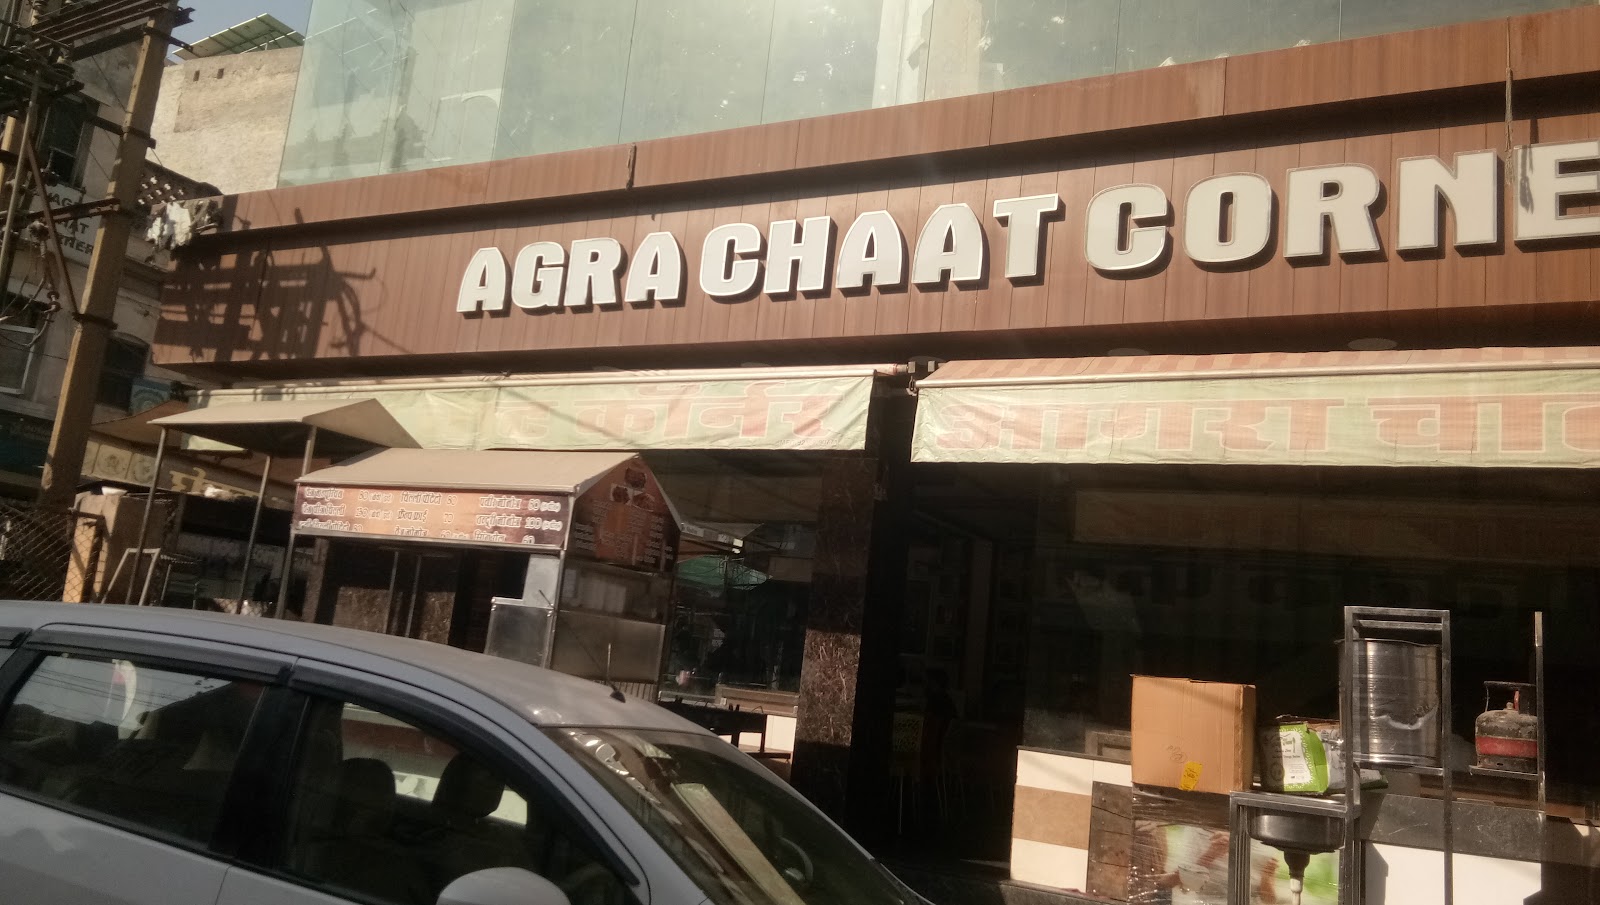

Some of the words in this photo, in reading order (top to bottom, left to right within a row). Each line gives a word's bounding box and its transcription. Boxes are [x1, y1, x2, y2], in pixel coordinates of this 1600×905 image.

[457, 231, 681, 313] AGRA
[699, 193, 1059, 297] CHAAT
[1084, 140, 1600, 271] CORNE
[936, 398, 1345, 451] आगरा
